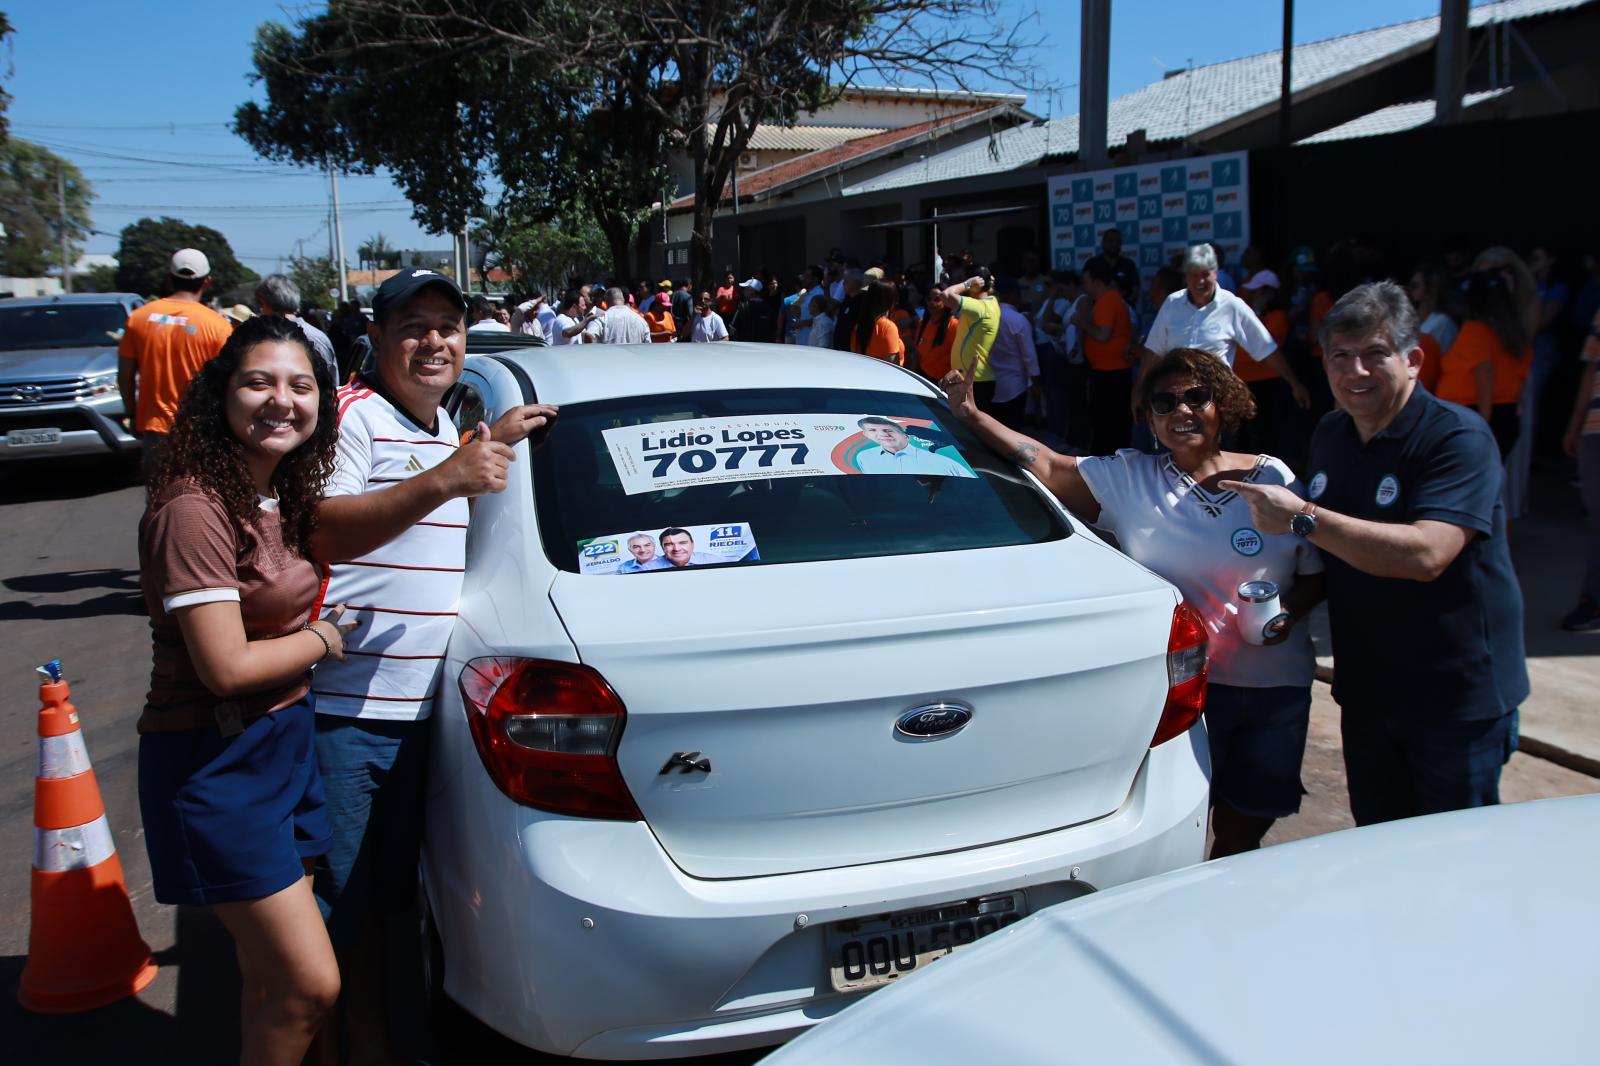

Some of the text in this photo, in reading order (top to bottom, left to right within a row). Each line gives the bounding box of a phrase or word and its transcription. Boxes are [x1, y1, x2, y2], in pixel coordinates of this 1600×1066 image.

[1143, 199, 1157, 216] 70
[1192, 194, 1208, 210] 70
[1057, 208, 1070, 223] 70
[1098, 204, 1111, 218] 70
[1059, 252, 1072, 266] 70
[640, 425, 716, 437] DEPUTADO
[642, 428, 805, 451] Lidio Lopes
[644, 443, 809, 479] 70777
[585, 544, 615, 556] 222
[915, 712, 957, 728] Ford
